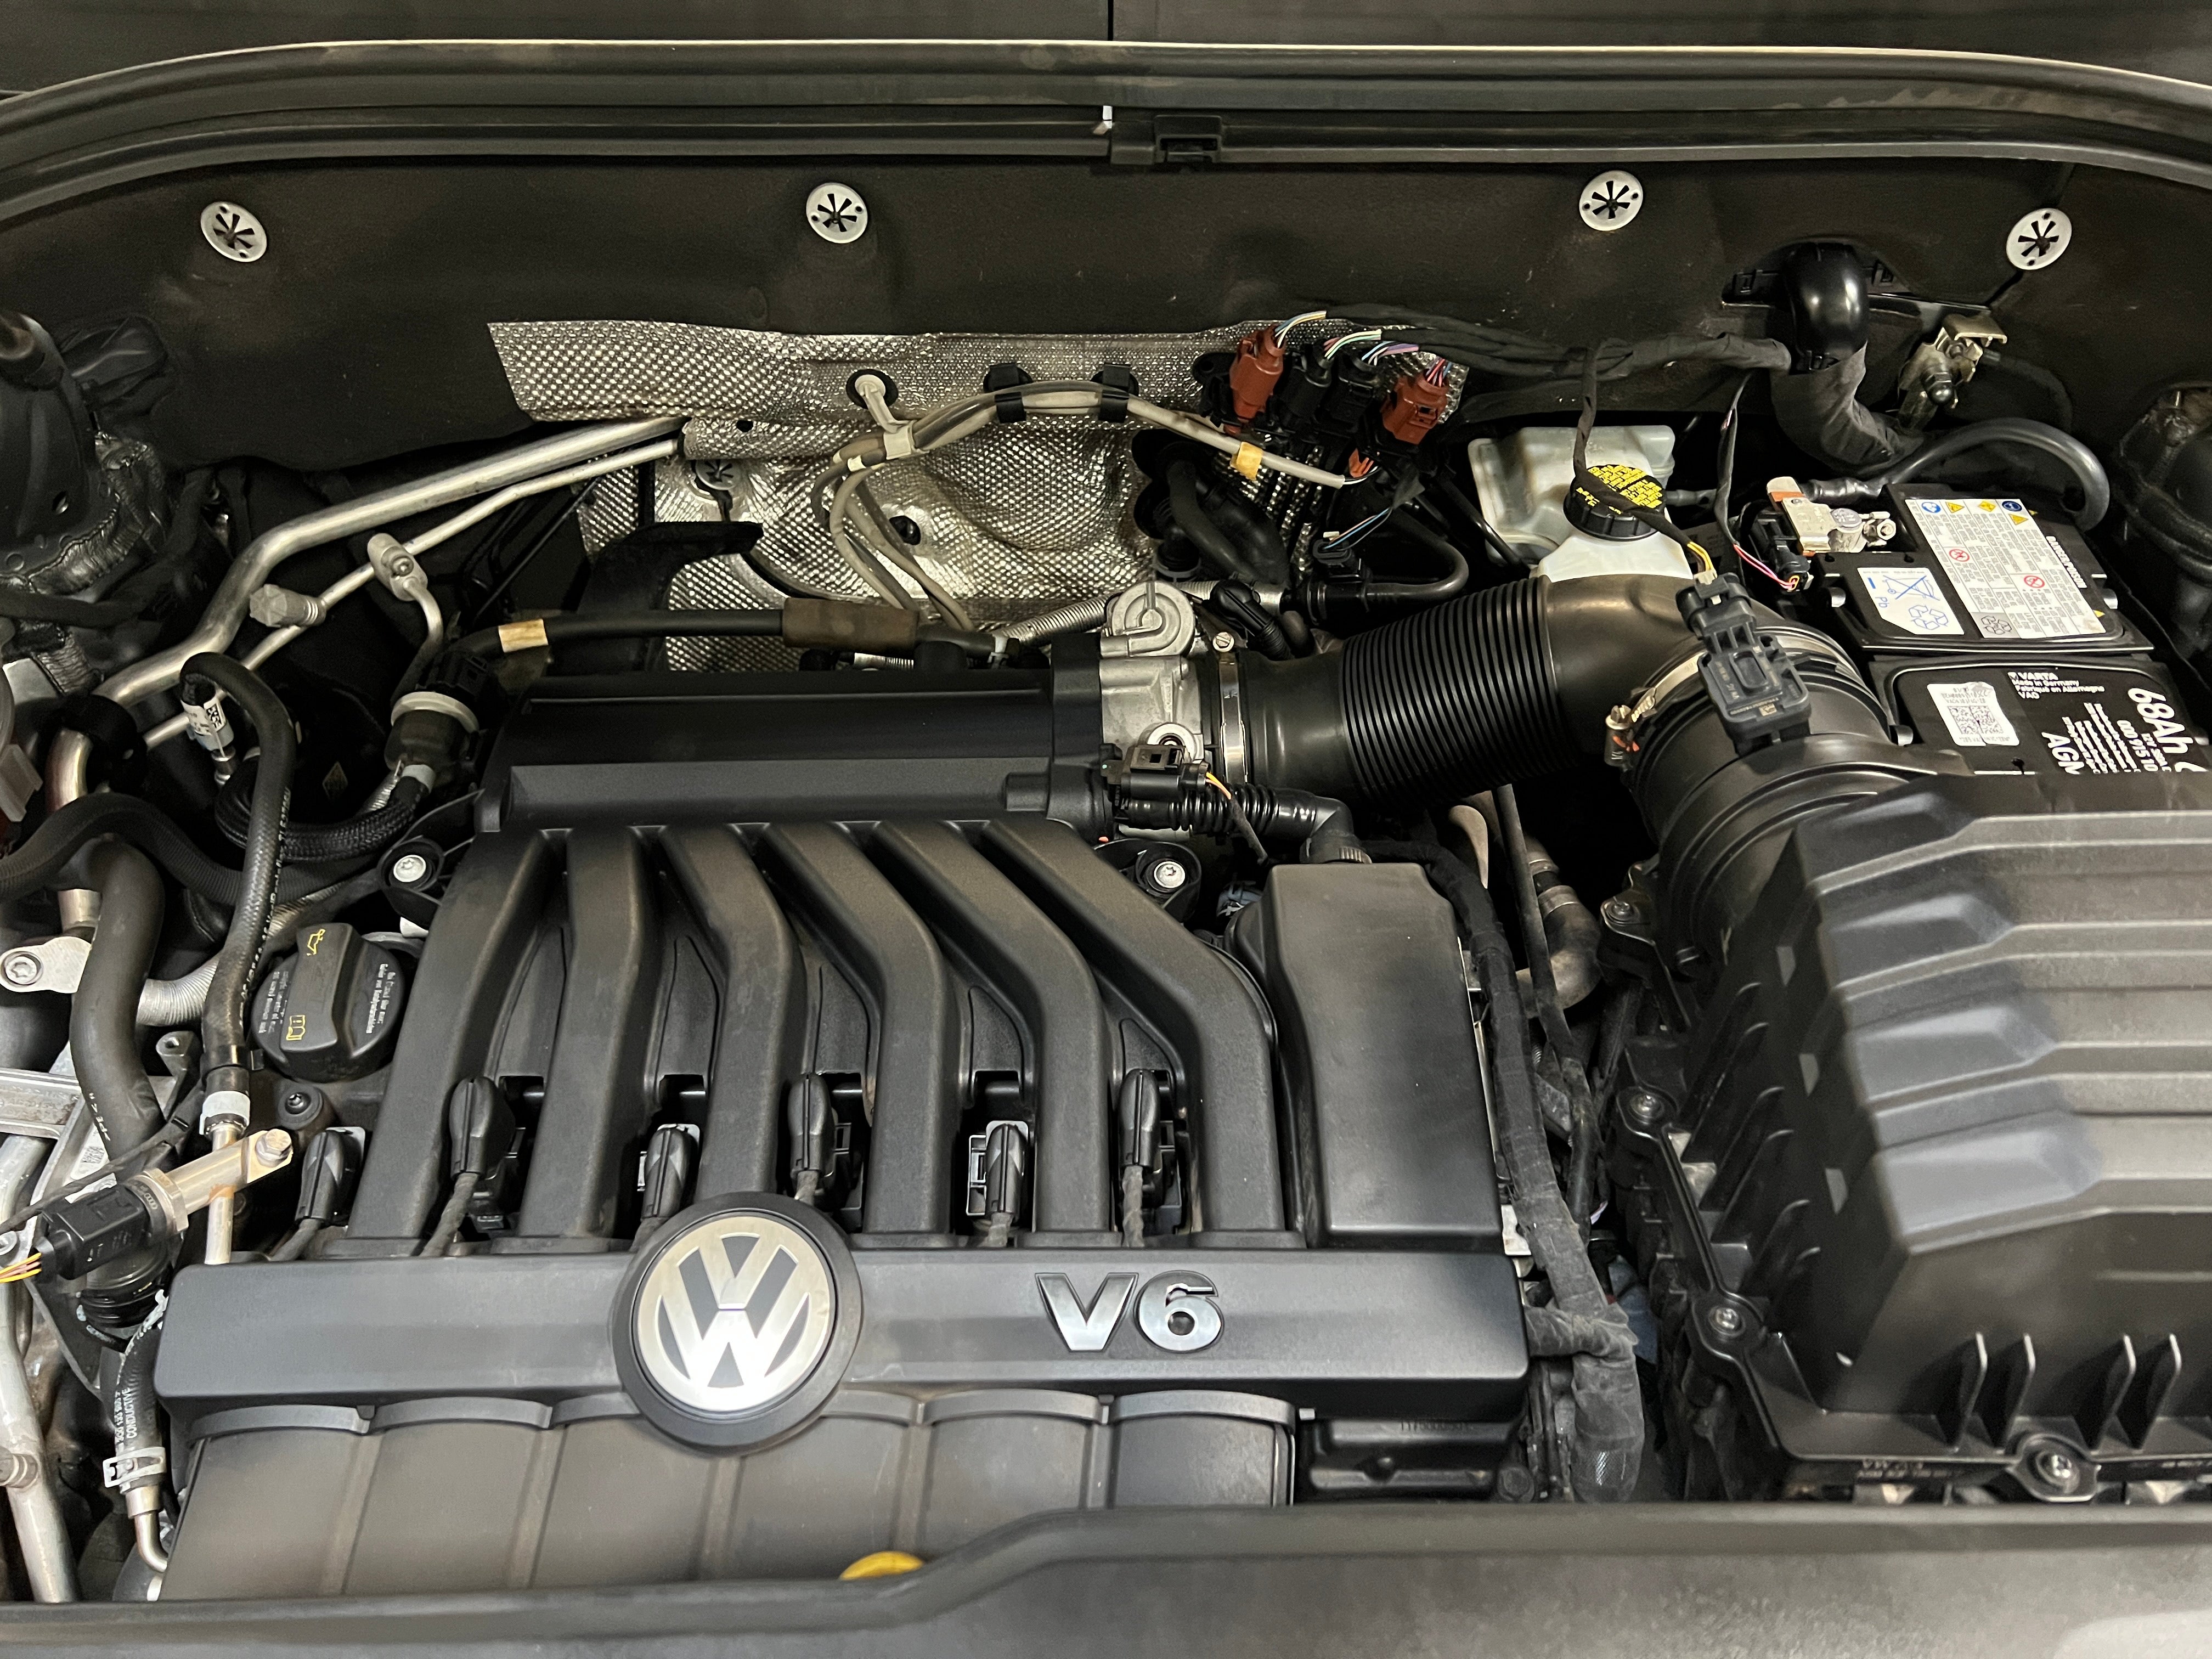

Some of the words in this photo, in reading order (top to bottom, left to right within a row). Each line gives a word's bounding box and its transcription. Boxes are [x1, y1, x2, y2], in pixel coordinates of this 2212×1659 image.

[1875, 597, 1889, 607] Pb
[2117, 720, 2138, 738] 000
[2129, 739, 2151, 757] 915
[2128, 688, 2193, 753] 68Ah
[638, 1216, 834, 1412] VW
[1036, 1271, 1223, 1353] V6
[122, 1387, 137, 1438] CONDUCTIVE
